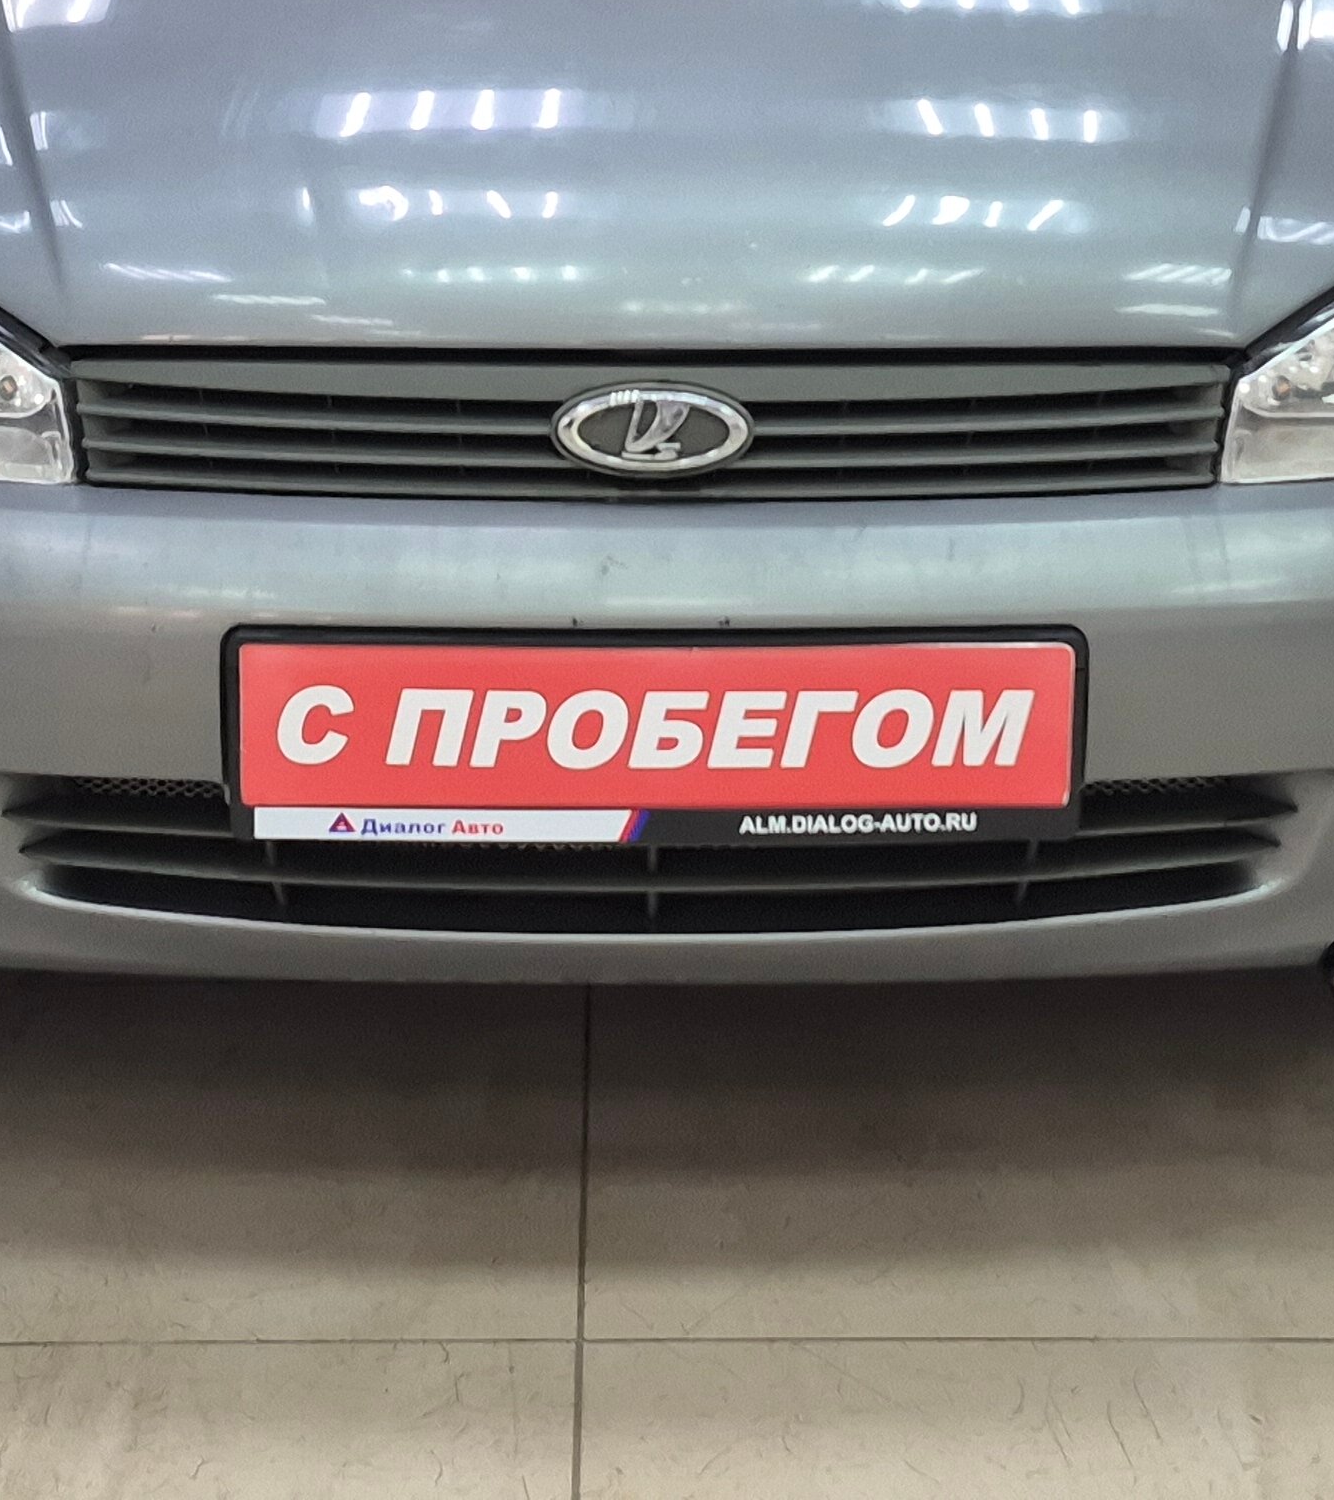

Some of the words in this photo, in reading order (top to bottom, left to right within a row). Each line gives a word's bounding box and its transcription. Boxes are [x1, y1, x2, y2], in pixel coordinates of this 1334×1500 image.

[275, 685, 353, 765] С
[384, 687, 1035, 769] ПРОБЕГОМ
[360, 818, 445, 836] Диалог
[451, 819, 504, 835] Авто
[739, 812, 977, 835] ALM.DIALOG-AUTO.RU
